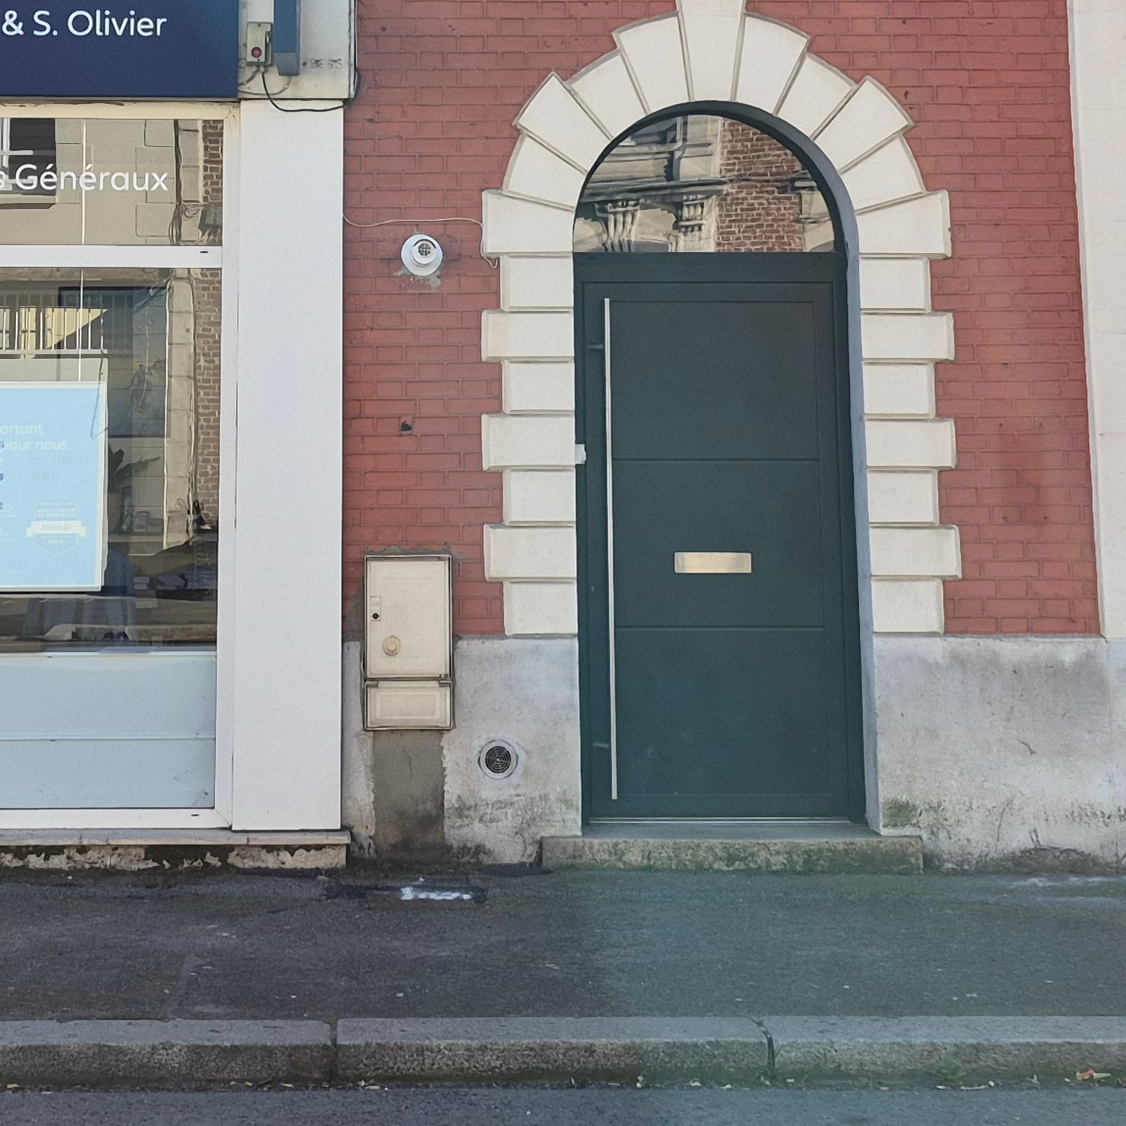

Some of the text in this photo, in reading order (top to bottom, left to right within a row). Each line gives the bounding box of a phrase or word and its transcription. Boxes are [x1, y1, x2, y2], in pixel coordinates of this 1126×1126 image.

[1, 10, 25, 36] &
[32, 10, 60, 37] S.
[67, 9, 168, 38] Olivier
[14, 163, 169, 193] Généraux
